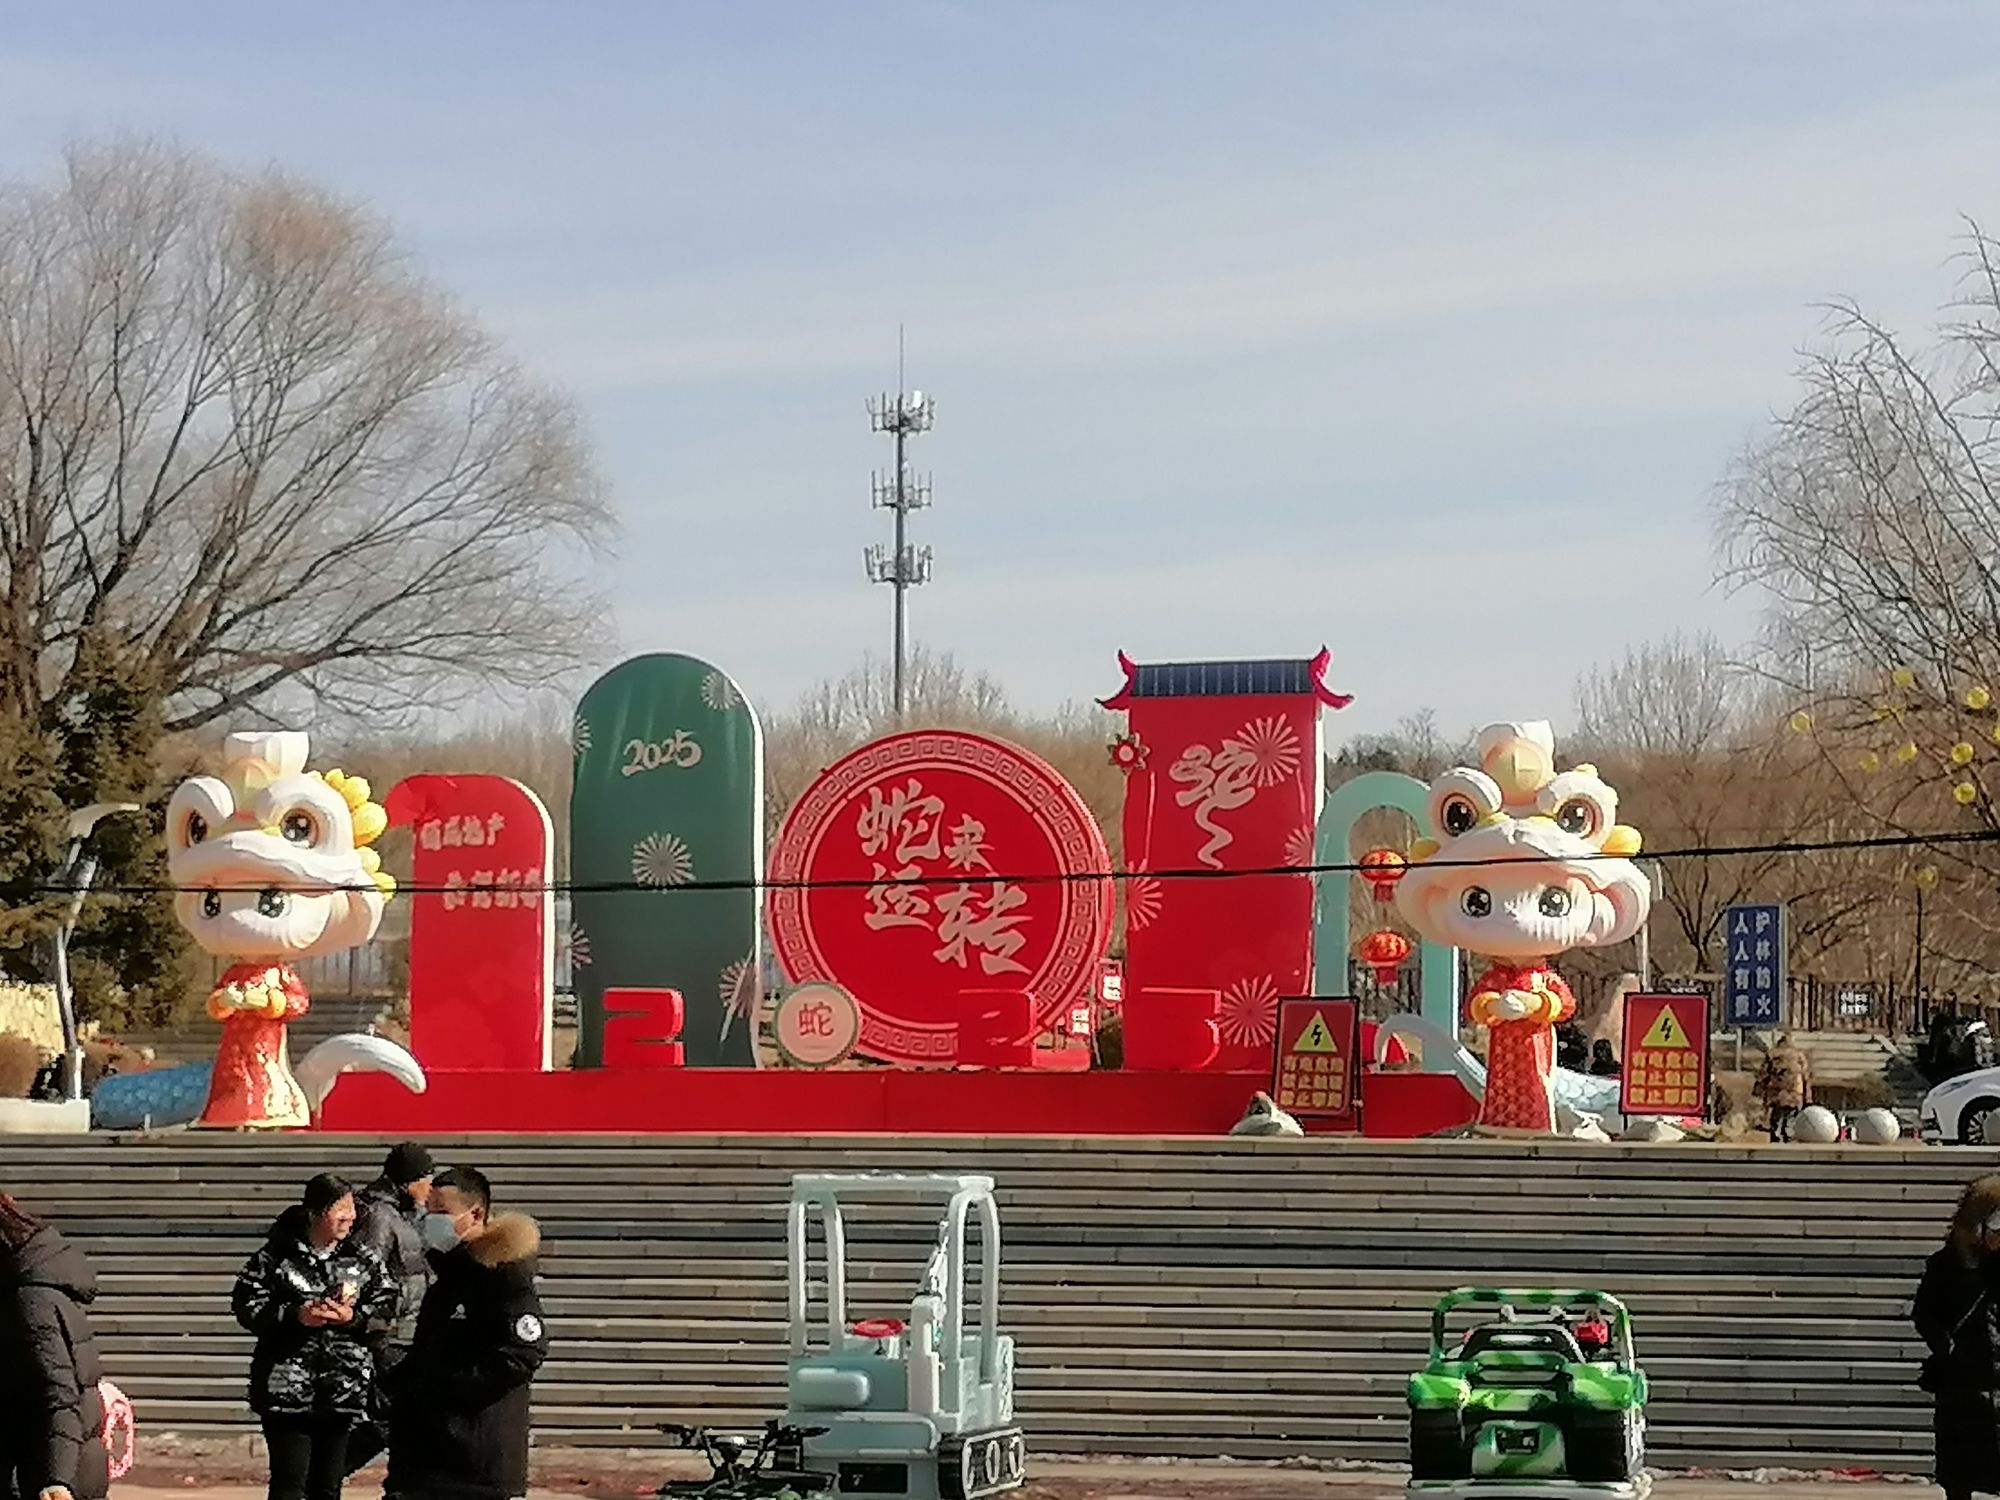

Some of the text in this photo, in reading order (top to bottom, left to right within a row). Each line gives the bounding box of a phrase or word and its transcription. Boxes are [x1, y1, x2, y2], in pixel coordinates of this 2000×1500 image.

[622, 729, 702, 777] 2025
[857, 778, 995, 872] 蛇来
[864, 863, 1033, 975] 运转
[1734, 912, 1749, 1018] 人人有责
[1755, 911, 1771, 1017] 护林防火
[602, 987, 685, 1068] 2
[799, 1001, 835, 1037] 蛇
